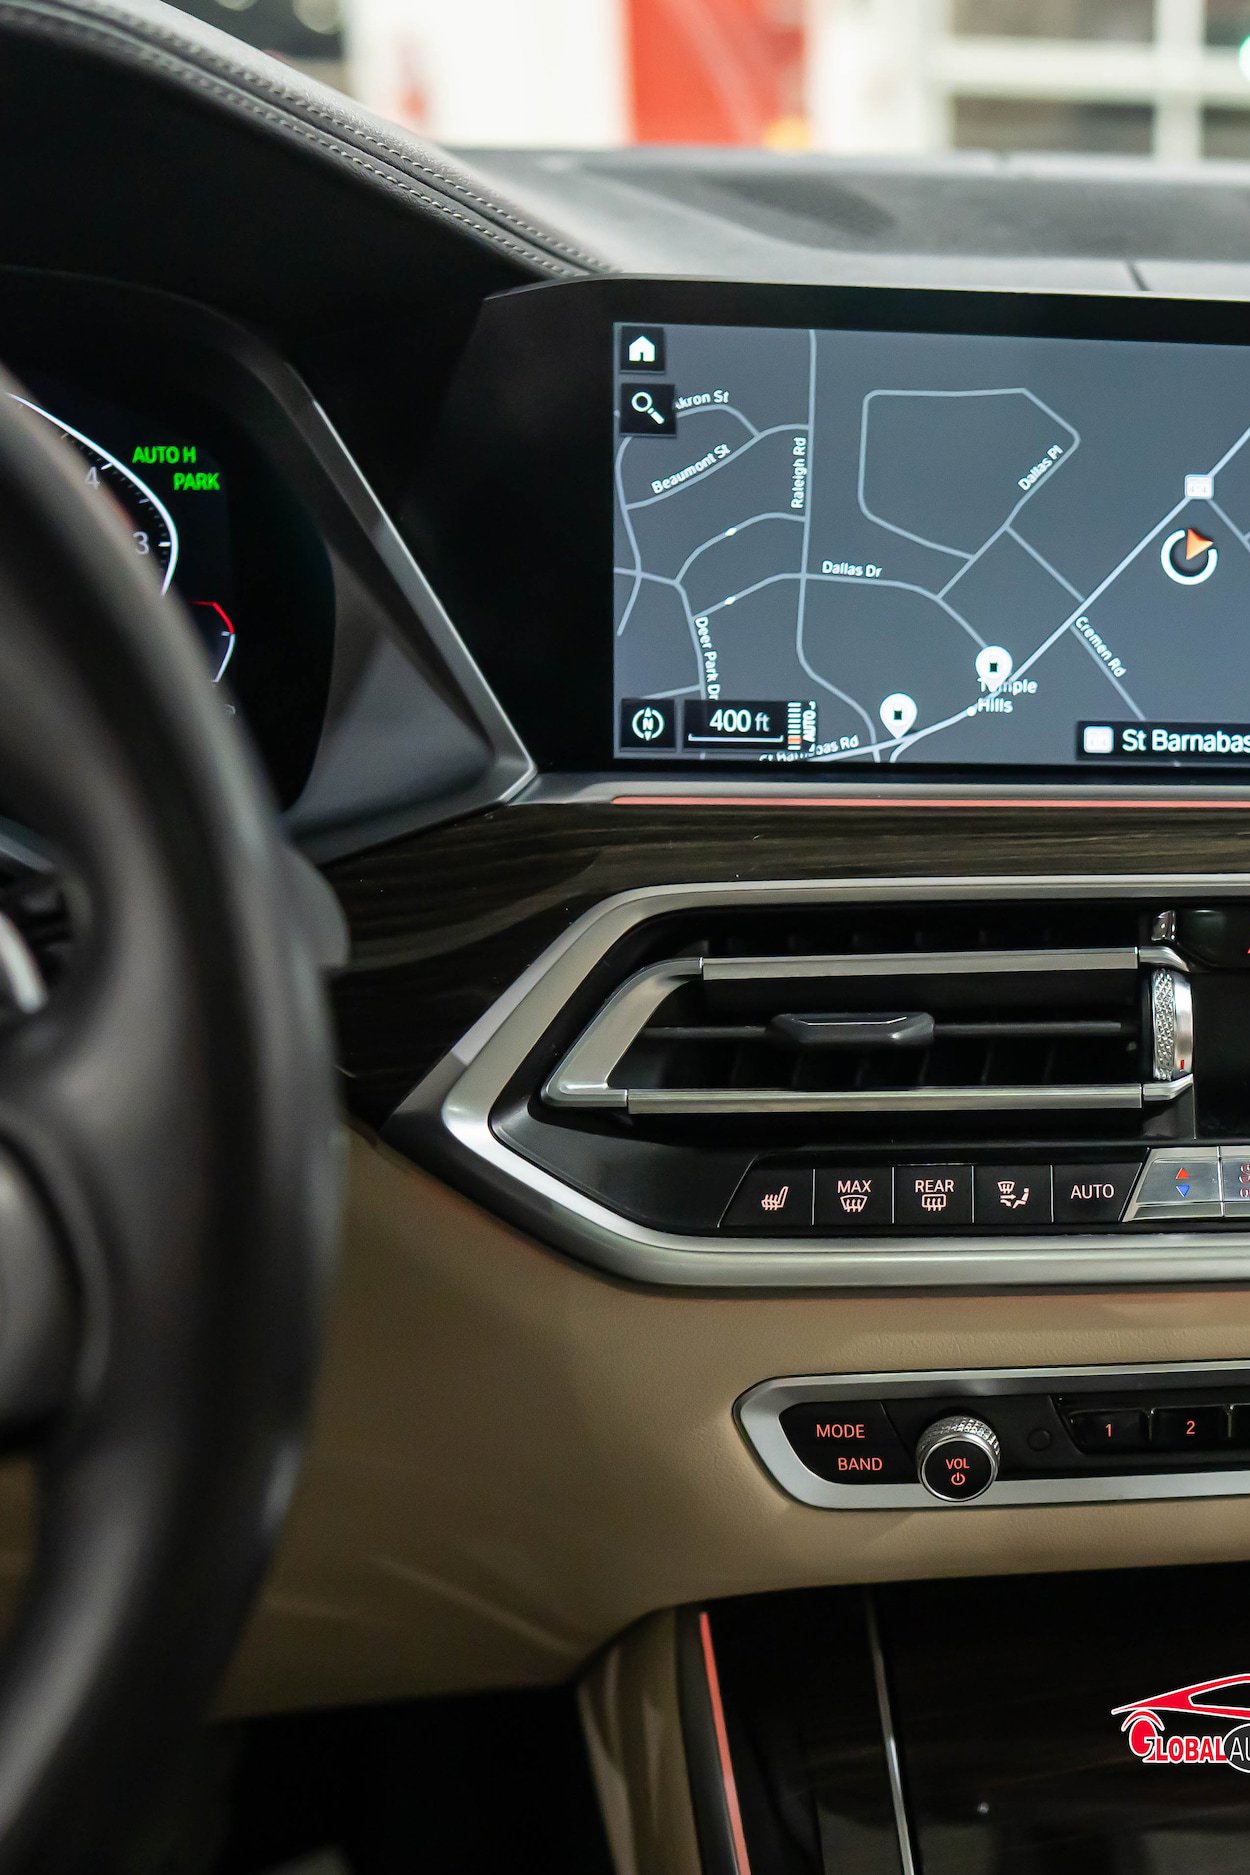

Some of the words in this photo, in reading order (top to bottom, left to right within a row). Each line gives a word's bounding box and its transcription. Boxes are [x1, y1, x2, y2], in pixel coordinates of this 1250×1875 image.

[674, 393, 711, 410] kron
[713, 390, 730, 404] St
[791, 436, 807, 455] Rd
[132, 446, 180, 464] AUTO
[183, 446, 197, 463] H
[651, 452, 717, 494] Beaumont
[713, 443, 731, 459] St
[1017, 457, 1053, 491] Dallas
[1047, 444, 1064, 460] Pl
[173, 472, 221, 491] PARK
[790, 458, 808, 509] Raleigh
[132, 531, 150, 555] 3
[821, 560, 863, 577] Dallas
[865, 563, 883, 578] Dr
[695, 616, 712, 649] Deer
[703, 651, 719, 683] Park
[1107, 657, 1127, 678] Rd
[707, 684, 720, 701] Dr
[977, 677, 1038, 696] Tmple
[977, 697, 1013, 713] Hills
[708, 709, 751, 732] 400
[754, 711, 770, 732] ft
[839, 735, 860, 751] Rd
[1122, 728, 1147, 752] St
[837, 1179, 872, 1194] MAX
[914, 1179, 955, 1193] REAR
[1070, 1183, 1115, 1199] AUTO
[816, 1423, 866, 1439] MODE
[1104, 1423, 1113, 1438] 1
[1186, 1420, 1196, 1436] 2
[837, 1456, 884, 1472] BAND
[945, 1457, 971, 1471] VOL
